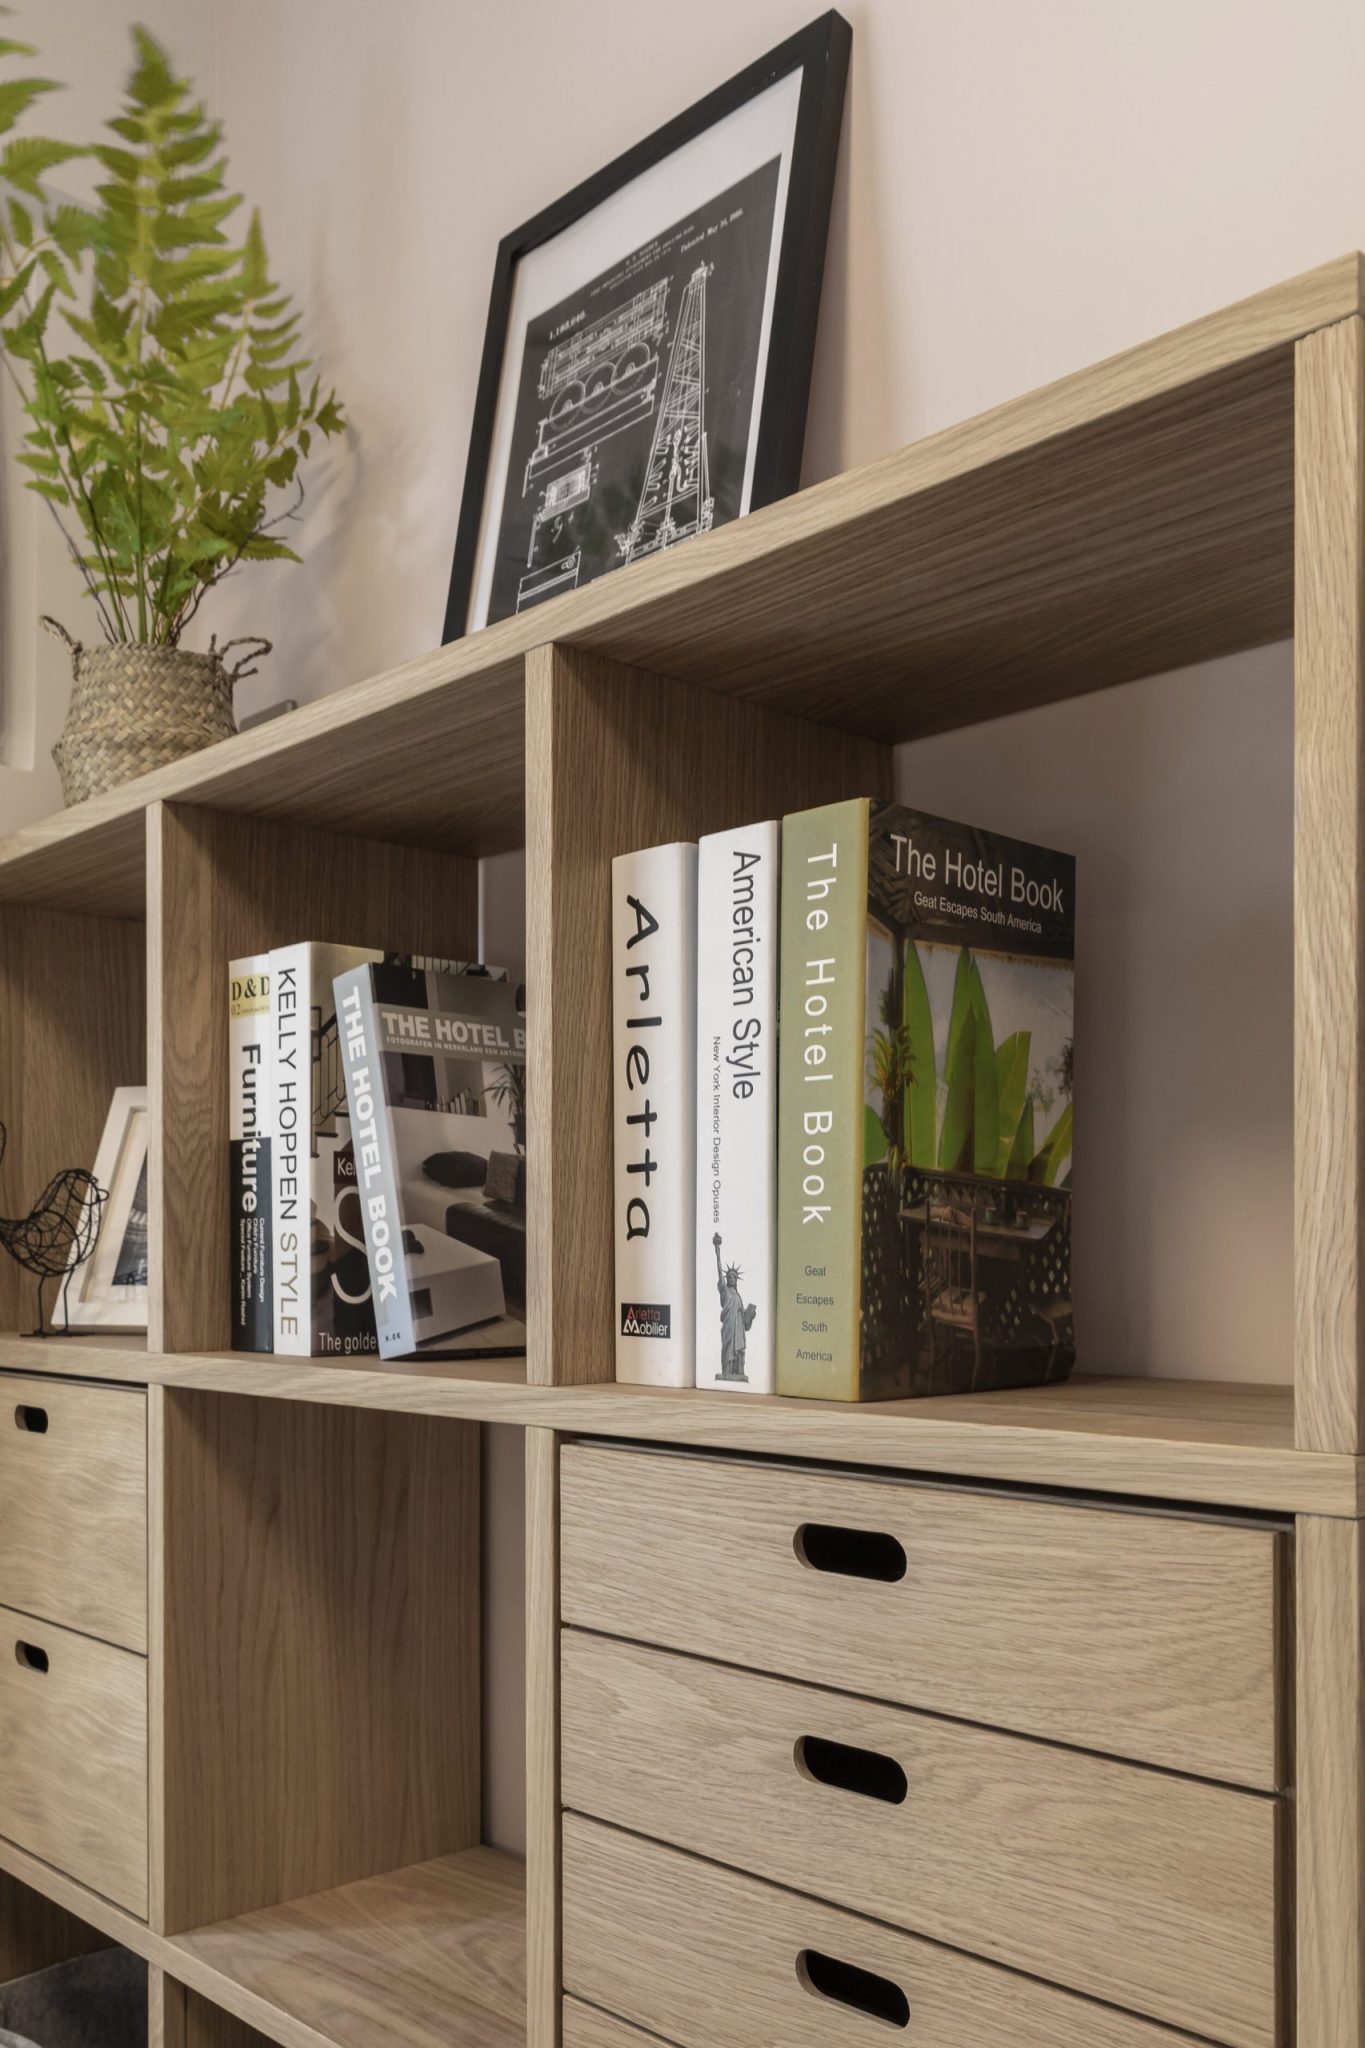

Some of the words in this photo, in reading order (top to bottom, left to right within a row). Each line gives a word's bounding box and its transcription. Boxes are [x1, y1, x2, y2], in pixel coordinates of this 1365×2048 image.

[806, 843, 838, 932] The
[889, 834, 936, 881] The
[944, 855, 1004, 897] Hotel
[1010, 866, 1064, 914] Book
[732, 850, 762, 1007] American
[913, 891, 938, 912] Geat
[938, 894, 979, 922] Escapes
[980, 902, 1007, 926] South
[1007, 908, 1042, 934] America
[277, 967, 298, 1072] KELLY
[341, 986, 367, 1062] THE
[381, 1011, 431, 1039] THE
[435, 1018, 509, 1048] HOTEL
[804, 959, 836, 1083] Hotel
[386, 1036, 433, 1048] FOTOGRAFEN
[444, 1043, 484, 1054] NEDERLAND
[485, 1048, 499, 1056] EEN
[625, 894, 663, 1241] Arletta
[713, 1036, 721, 1061] New
[725, 1016, 762, 1100] Style
[713, 1064, 721, 1091] York
[241, 1043, 262, 1213] Furniture
[352, 1069, 384, 1189] HOTEL
[713, 1094, 721, 1134] Interior
[278, 1081, 298, 1220] HOPPEN
[711, 1137, 721, 1176] Design
[802, 1110, 834, 1226] Book
[711, 1180, 721, 1224] Opuses
[367, 1194, 398, 1303] BOOK
[804, 1264, 827, 1277] Geat
[279, 1231, 299, 1336] STYLE
[796, 1293, 835, 1308] Escapes
[622, 1319, 669, 1336] Mobilier
[627, 1306, 661, 1322] Arletta
[801, 1321, 828, 1334] South
[319, 1332, 341, 1351] The
[796, 1348, 833, 1364] America
